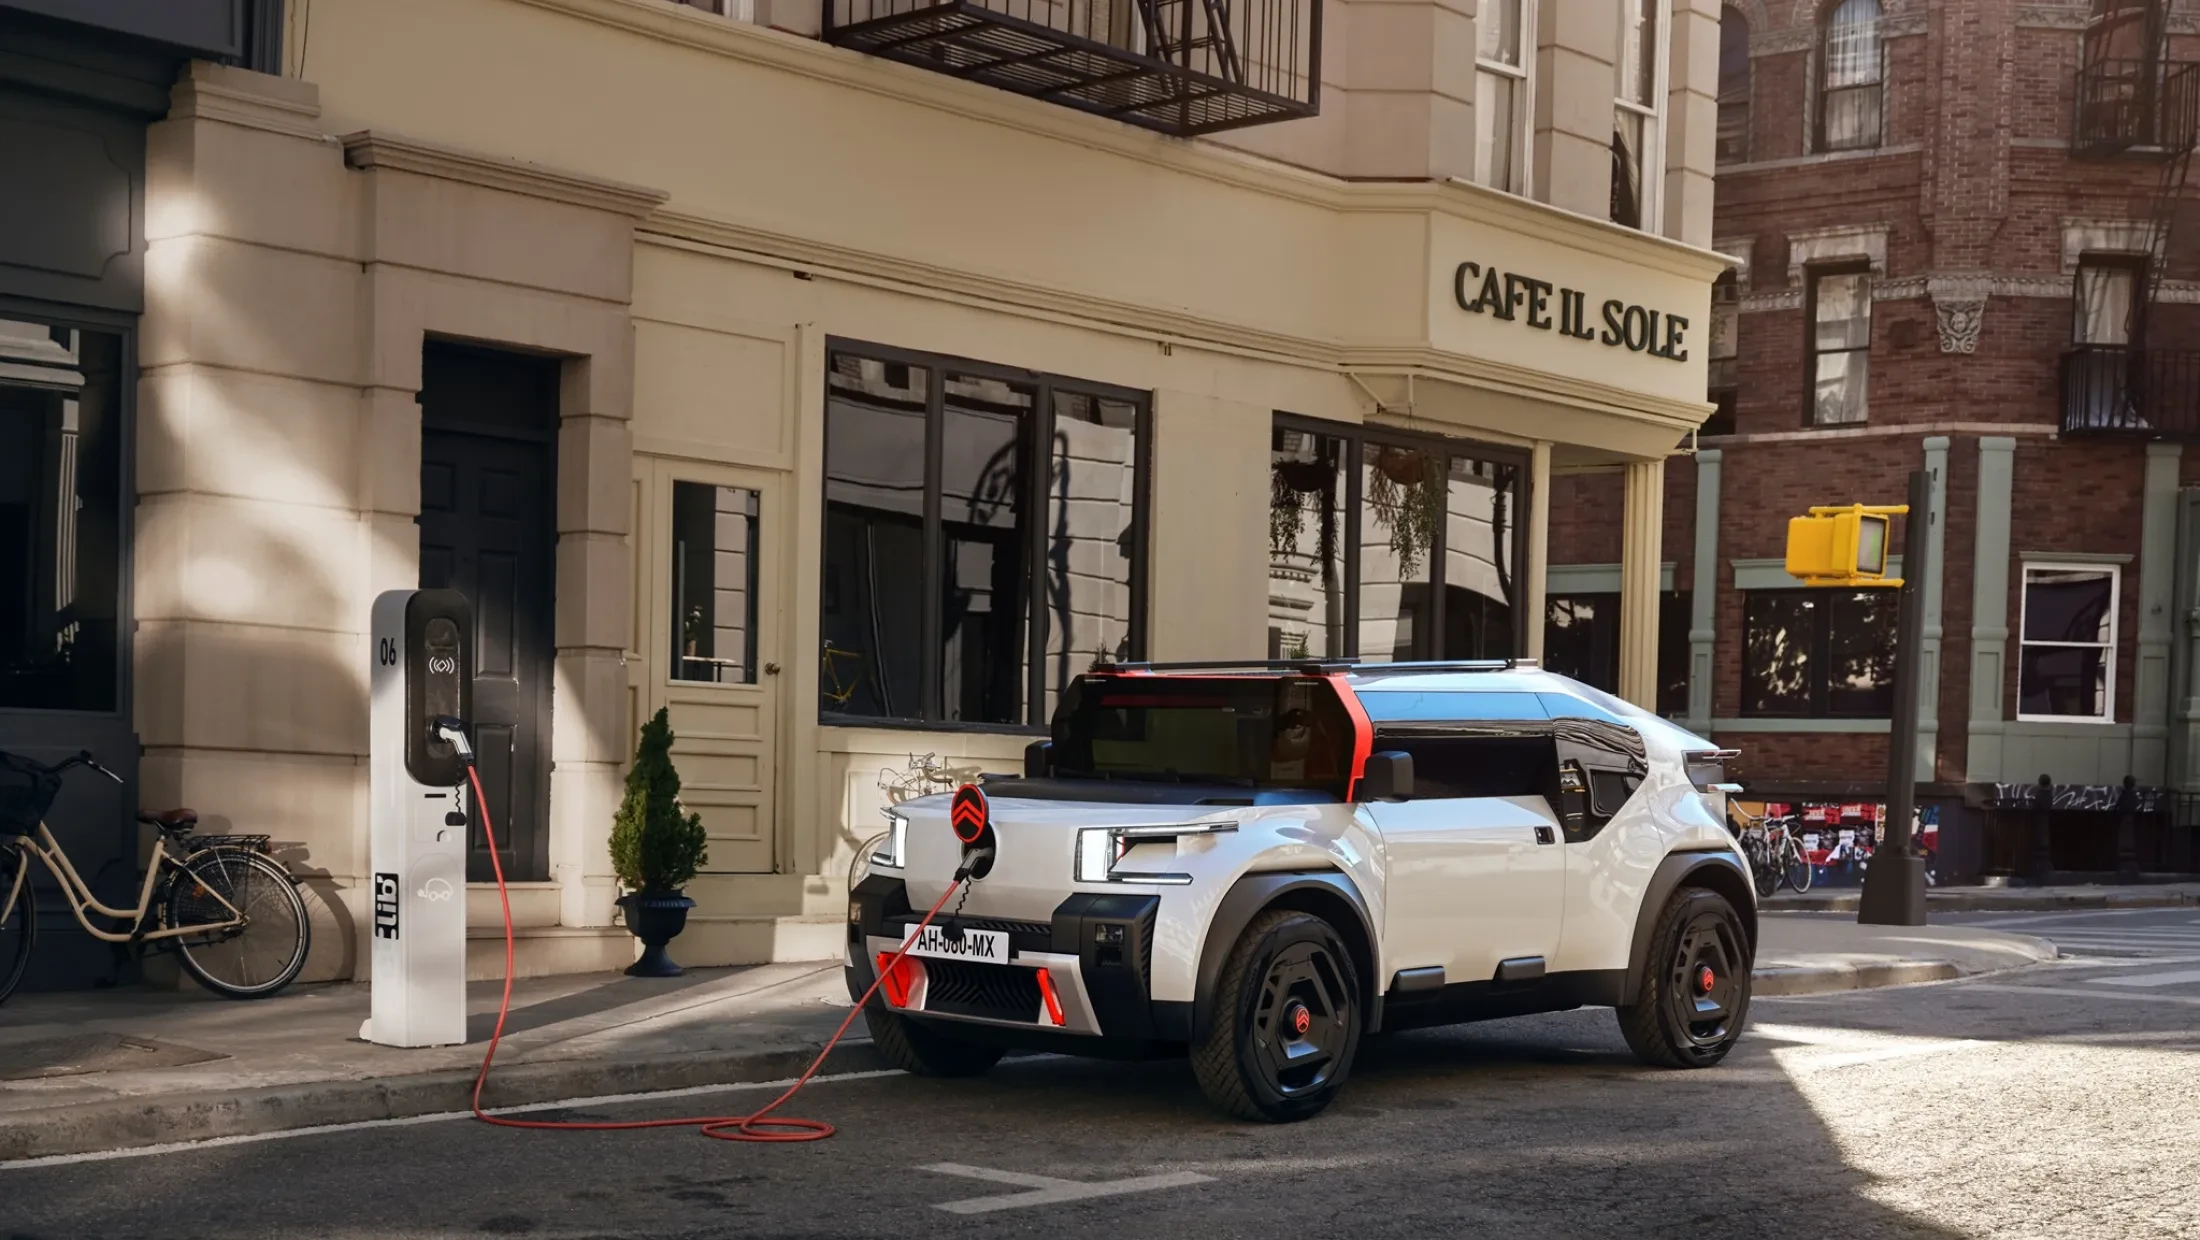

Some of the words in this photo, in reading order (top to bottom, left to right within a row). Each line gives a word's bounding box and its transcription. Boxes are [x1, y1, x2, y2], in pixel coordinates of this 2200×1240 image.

[1454, 261, 1553, 330] CAFE
[1559, 288, 1594, 340] IL
[1602, 300, 1689, 361] SOLE
[380, 637, 396, 666] 06
